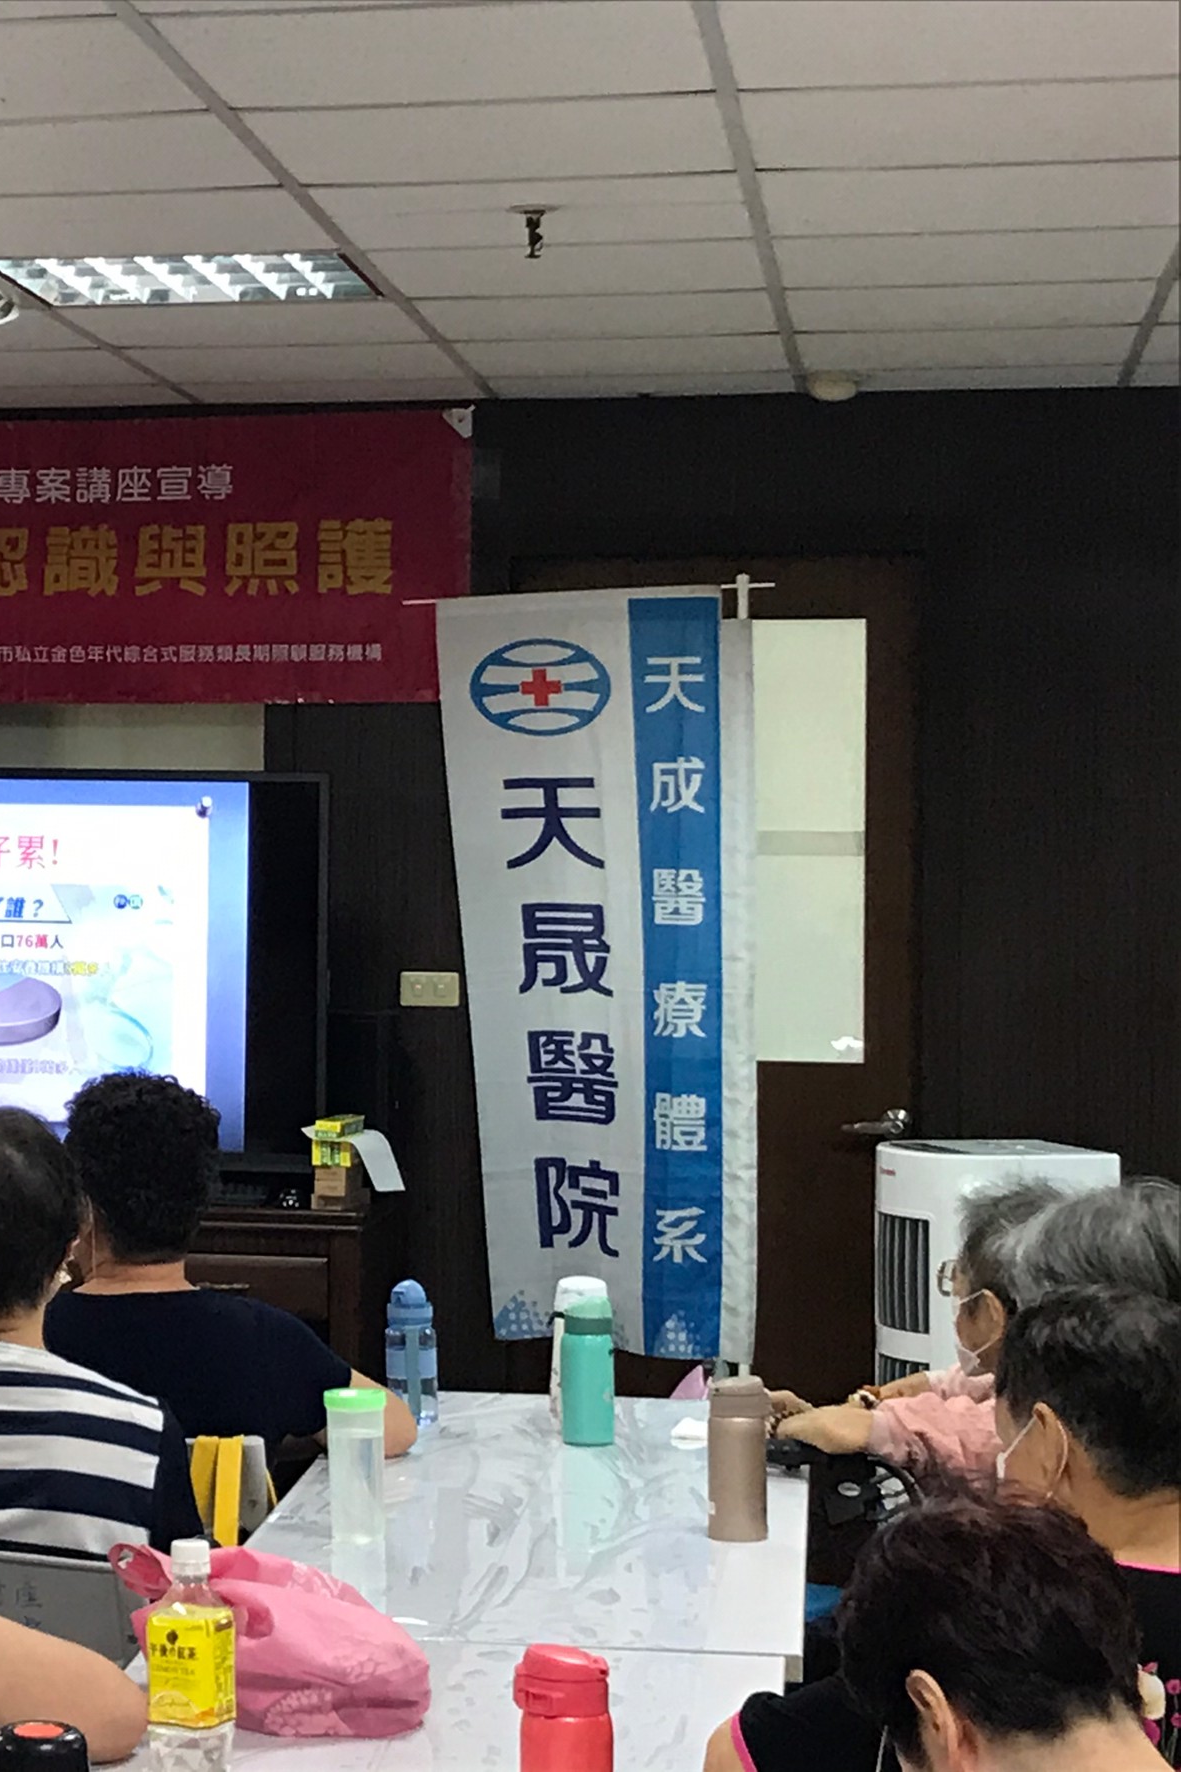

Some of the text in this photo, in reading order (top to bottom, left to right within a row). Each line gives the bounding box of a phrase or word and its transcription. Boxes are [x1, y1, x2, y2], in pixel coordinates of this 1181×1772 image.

[499, 776, 620, 1258] 天晟醫院
[642, 655, 709, 1264] 天成醫療體系
